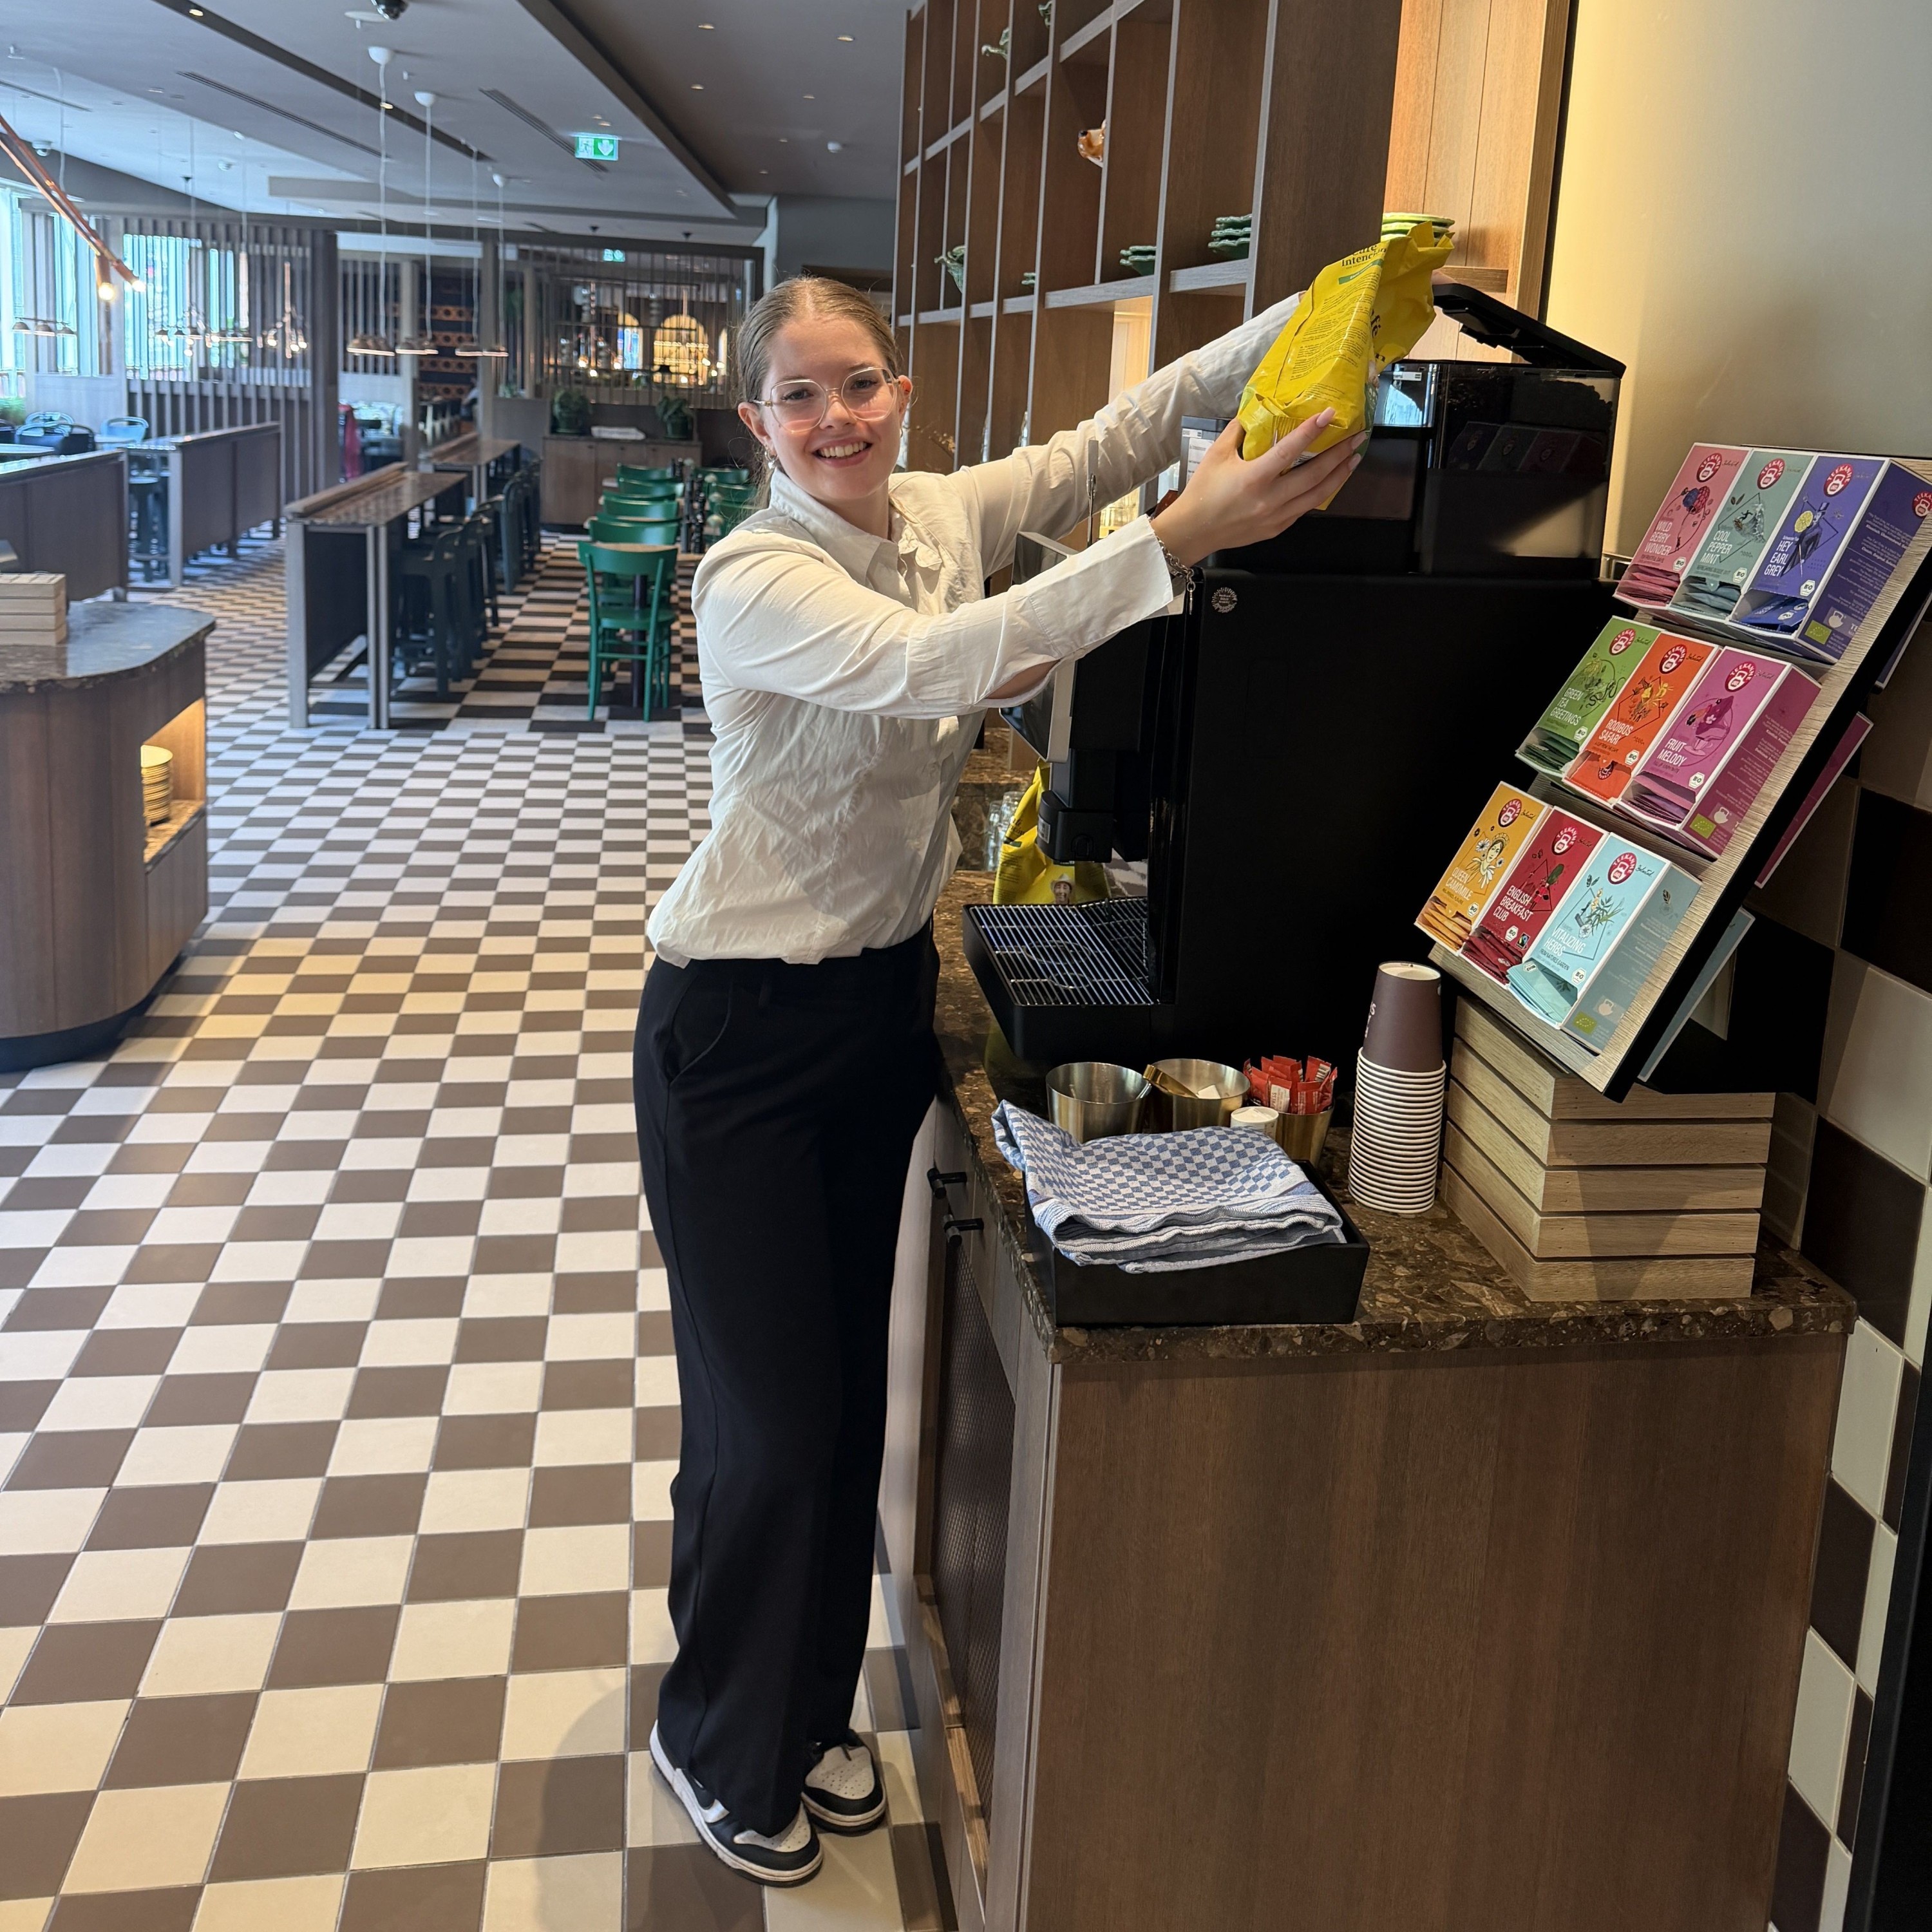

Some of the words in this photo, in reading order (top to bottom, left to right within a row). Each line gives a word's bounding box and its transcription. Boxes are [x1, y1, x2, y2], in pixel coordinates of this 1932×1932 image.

[1655, 522, 1672, 532] WILD
[1649, 532, 1671, 543] BERRY
[1713, 530, 1730, 542] COOL
[1644, 542, 1672, 555] WONDER
[1707, 542, 1733, 554] PEPPER
[1777, 540, 1792, 552] HEY
[1700, 553, 1719, 564] MINT
[1770, 553, 1789, 565] EARL
[1764, 564, 1785, 577] GREY
[1564, 687, 1584, 701] GREEN
[1557, 697, 1569, 709] TEA
[1550, 706, 1582, 726] GREETINGS
[1605, 719, 1634, 736] ROOIBOS
[1599, 730, 1622, 745] SAFARI
[1664, 738, 1687, 753] FRUIT
[1657, 749, 1687, 767] MELODY
[1451, 867, 1470, 884] QUEEN
[1445, 877, 1473, 900] CAMOMILE
[1506, 885, 1532, 906] ENGLISH
[1493, 907, 1507, 922] CLUB
[1499, 895, 1534, 922] BREAKFAST
[1544, 936, 1566, 956] HERBS
[1552, 927, 1586, 953] VITALIZING
